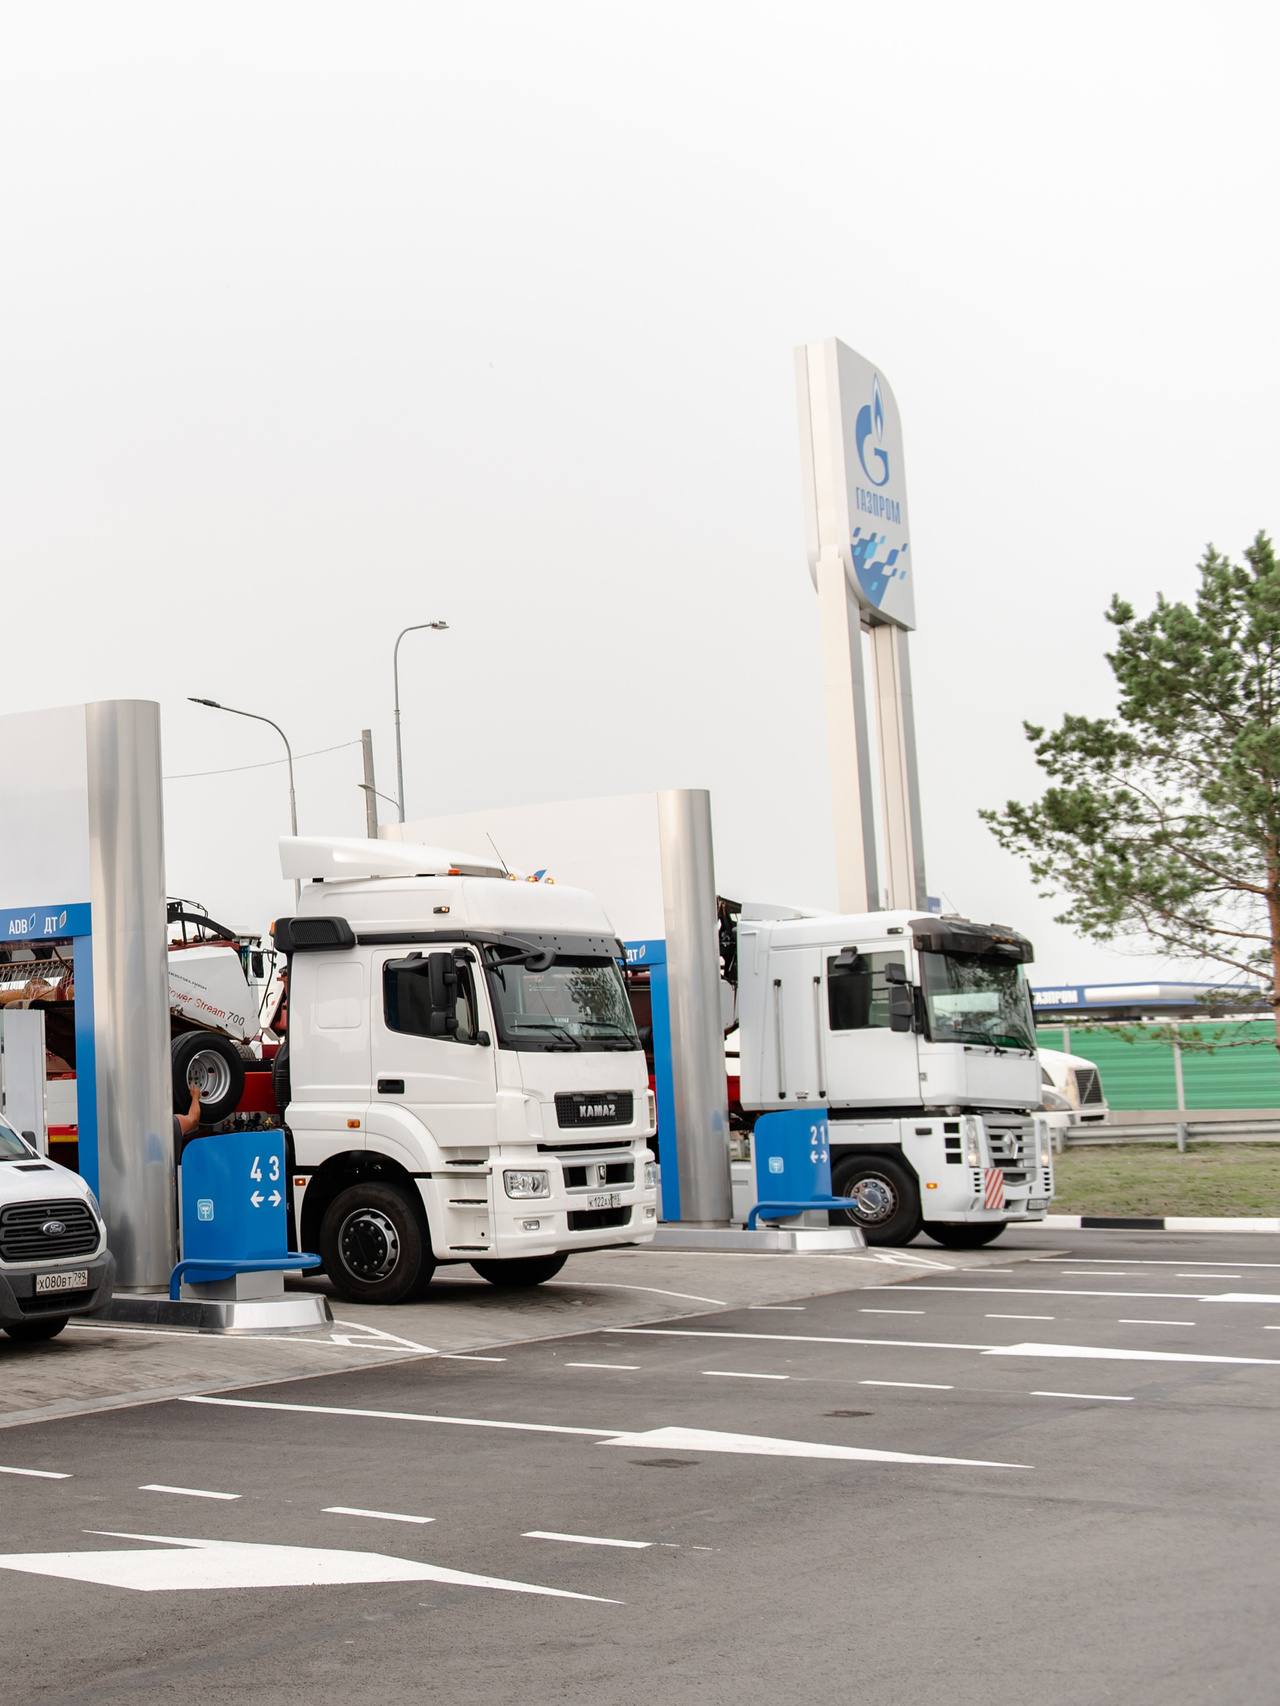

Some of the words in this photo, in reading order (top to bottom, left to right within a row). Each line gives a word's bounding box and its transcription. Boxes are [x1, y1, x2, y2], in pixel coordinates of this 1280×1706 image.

[855, 486, 901, 525] ГАЗПРОМ
[8, 919, 27, 935] ADB
[43, 916, 58, 934] ДТ
[626, 949, 638, 963] ДТ
[194, 998, 226, 1019] Stream
[227, 1011, 245, 1026] 700
[579, 1104, 616, 1118] KAMAZ
[810, 1125, 818, 1145] 2
[820, 1125, 825, 1144] 1
[250, 1156, 262, 1182] 4
[269, 1155, 280, 1181] 3
[48, 1223, 63, 1233] Ford
